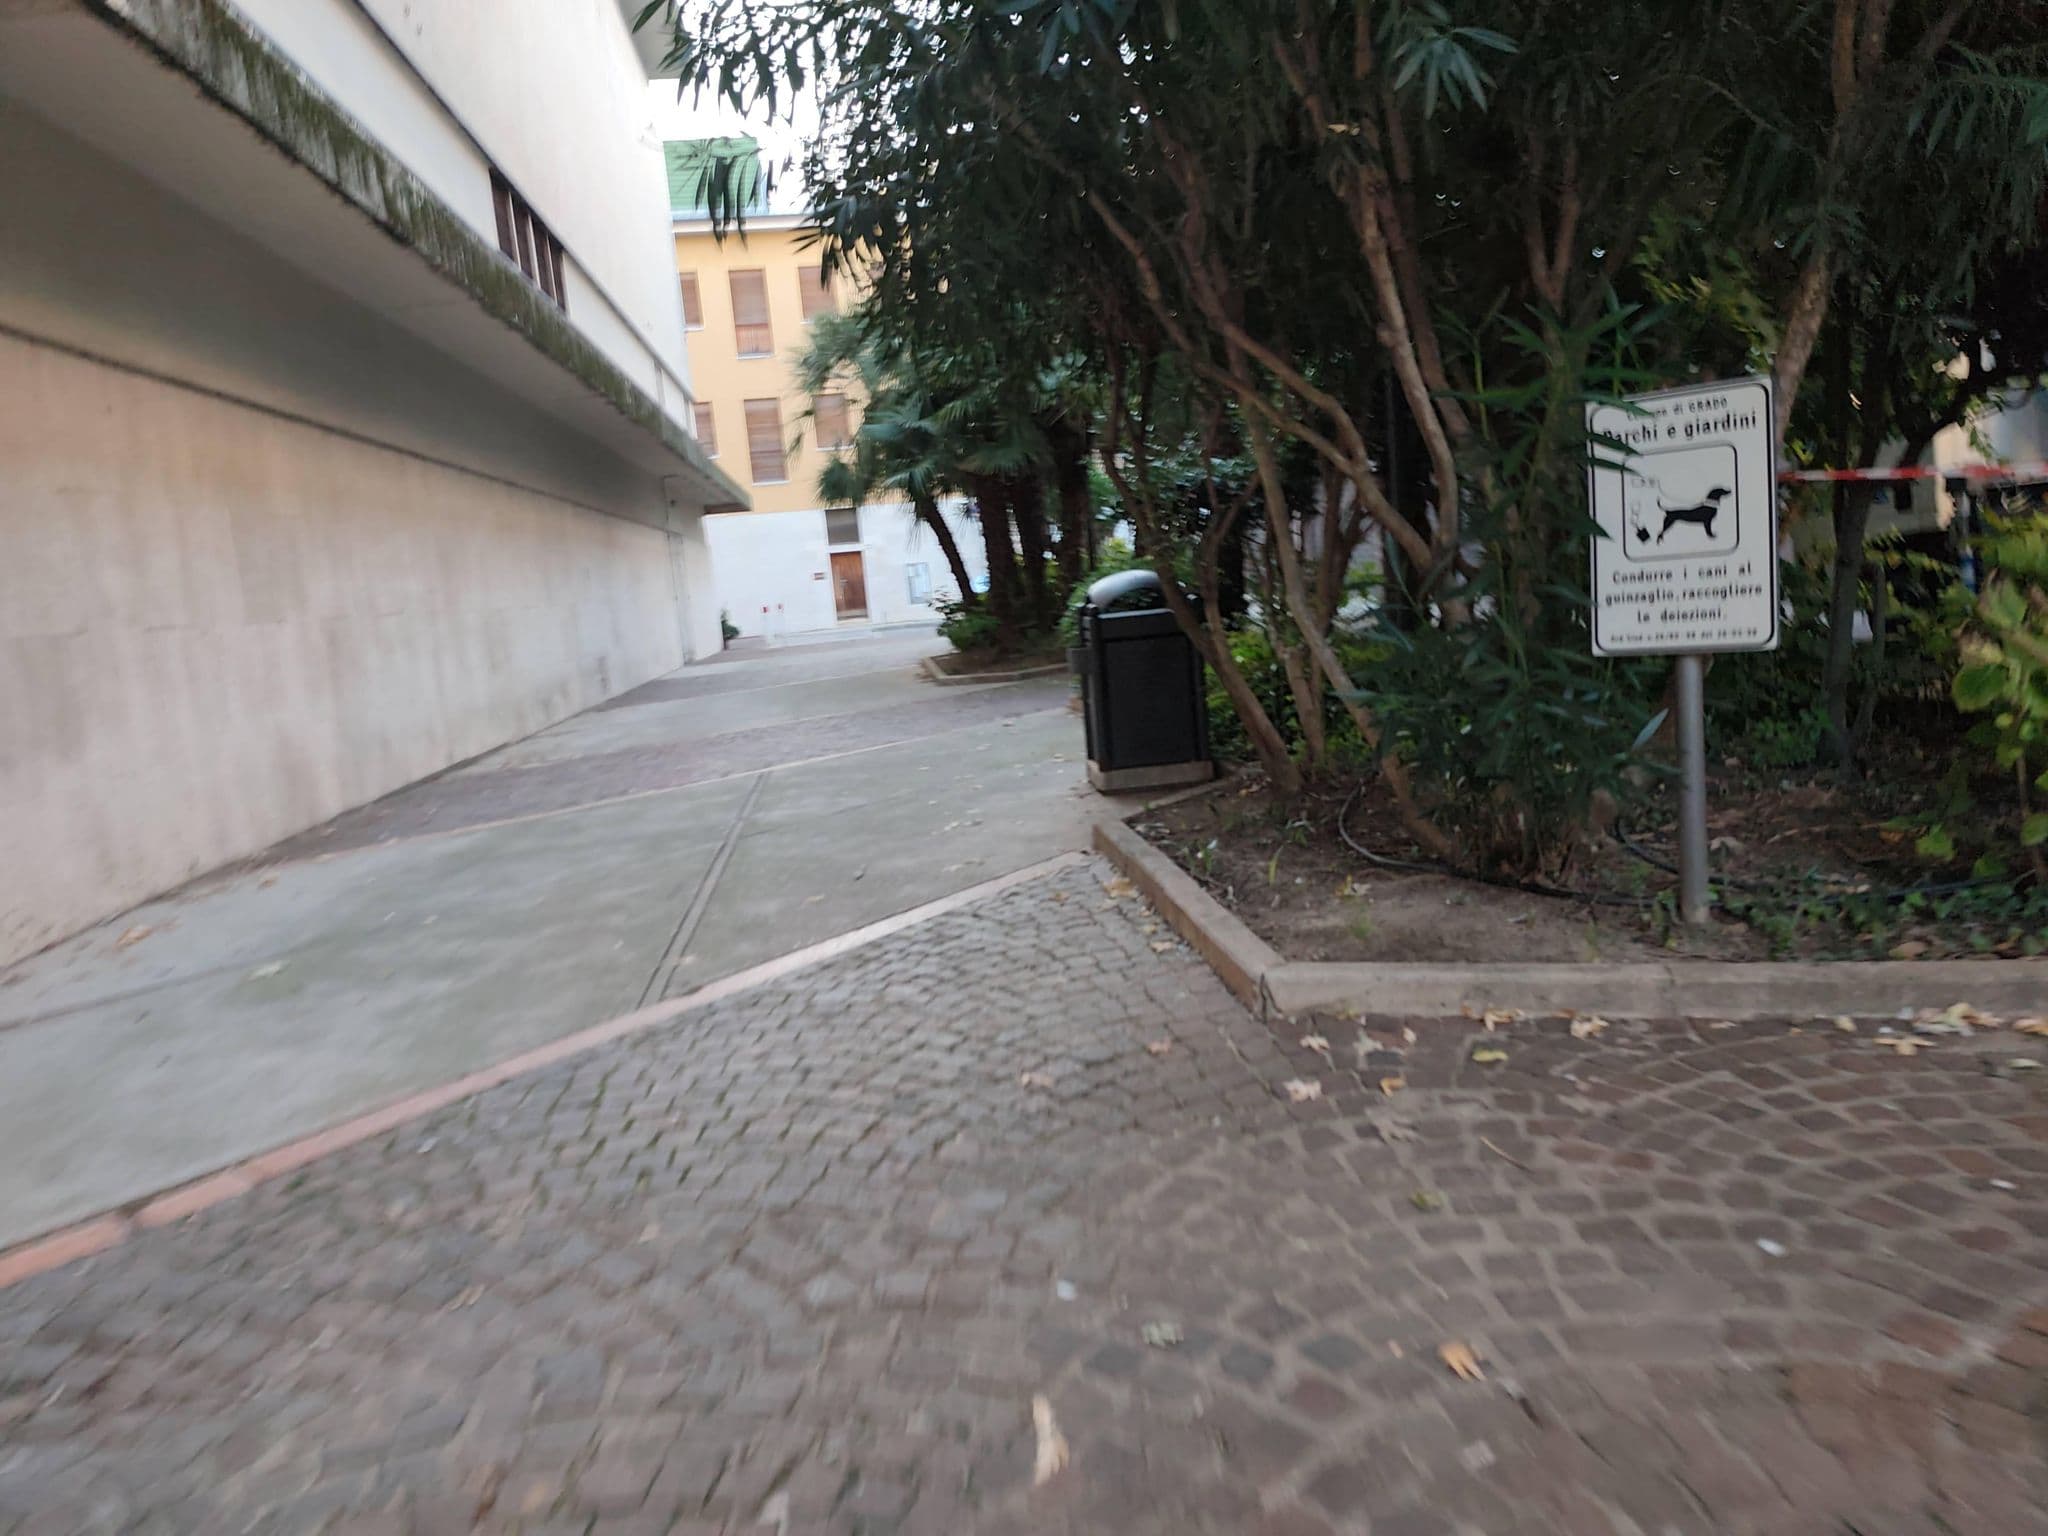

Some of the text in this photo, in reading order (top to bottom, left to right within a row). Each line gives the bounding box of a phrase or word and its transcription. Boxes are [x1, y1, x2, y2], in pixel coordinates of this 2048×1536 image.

[1688, 397, 1728, 413] GRADO
[1666, 424, 1677, 439] e
[1684, 410, 1757, 441] giardini
[1612, 568, 1674, 585] Condurre
[1697, 563, 1728, 578] cani
[1738, 559, 1752, 576] al
[1681, 583, 1764, 602] raccogliere
[1636, 608, 1651, 624] le
